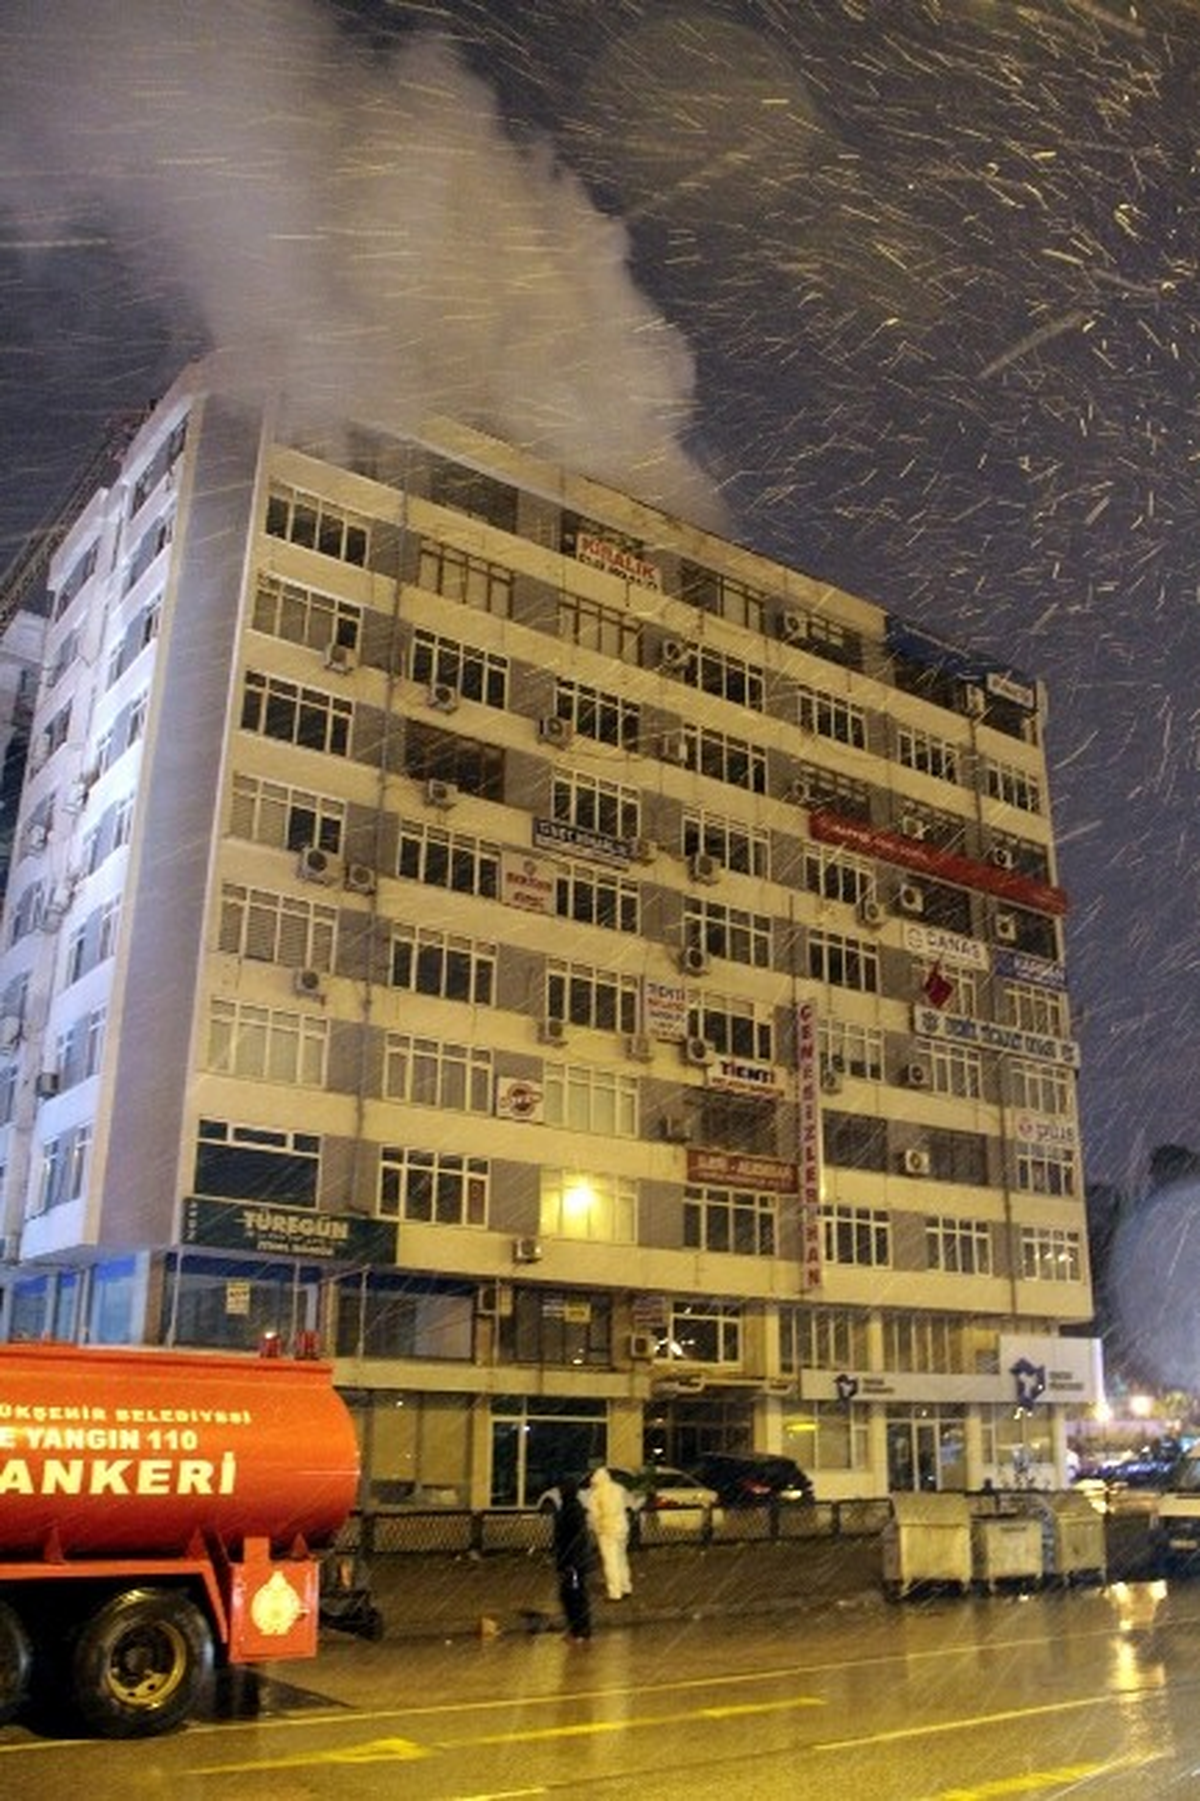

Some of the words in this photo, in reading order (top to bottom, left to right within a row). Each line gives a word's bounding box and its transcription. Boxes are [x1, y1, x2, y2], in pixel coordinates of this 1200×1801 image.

[25, 1428, 140, 1450] YANGIN
[147, 1429, 198, 1450] 110
[0, 1451, 236, 1494] ANKERİ
